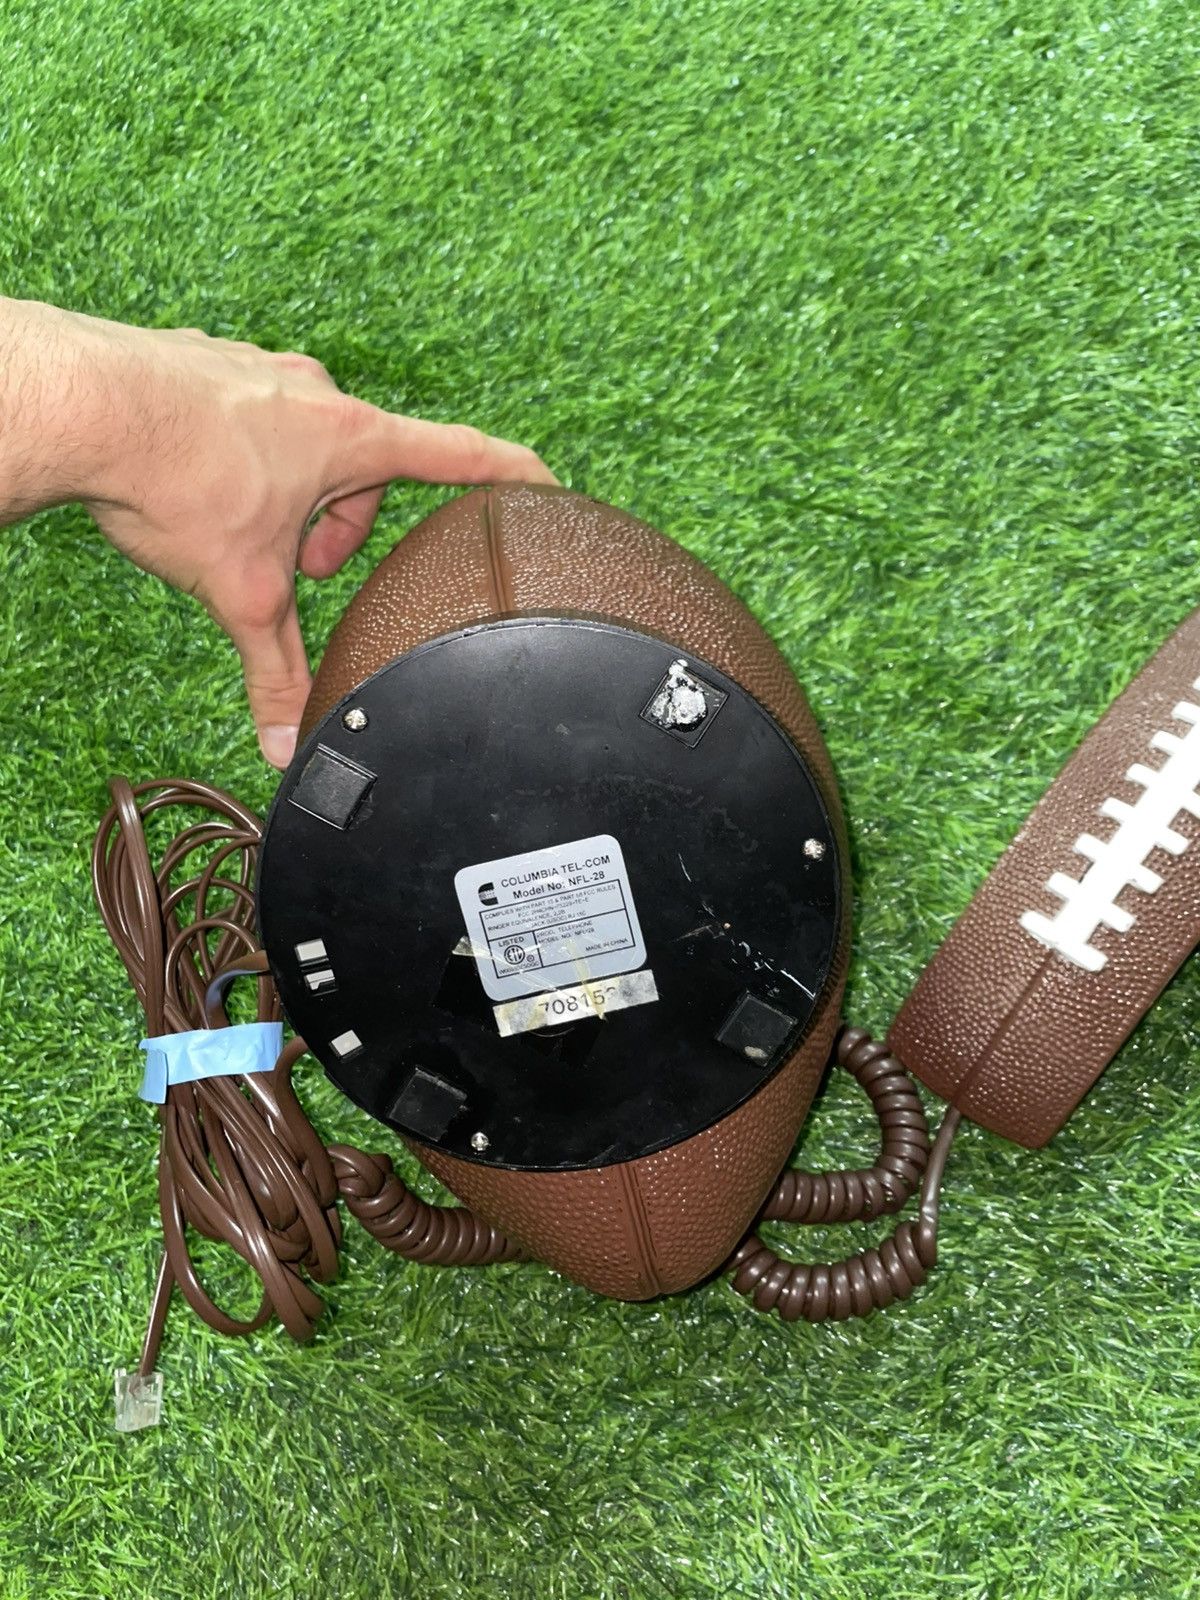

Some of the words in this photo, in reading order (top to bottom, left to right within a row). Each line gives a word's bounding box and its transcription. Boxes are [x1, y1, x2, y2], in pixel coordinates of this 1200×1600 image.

[500, 867, 559, 888] COLUMBIA
[561, 855, 610, 874] TEL-COM
[513, 885, 545, 900] Model
[547, 880, 565, 891] No:
[568, 870, 605, 886] NFL-28
[484, 909, 514, 920] COMPLIES
[531, 901, 545, 909] PART
[560, 894, 574, 902] PART
[597, 884, 616, 893] RULES
[488, 922, 510, 932] RINGER
[558, 920, 593, 933] TELEPHONE
[498, 936, 525, 947] LISTED
[538, 935, 559, 945] MODEL
[586, 944, 601, 952] MADE
[610, 937, 628, 946] CHINA
